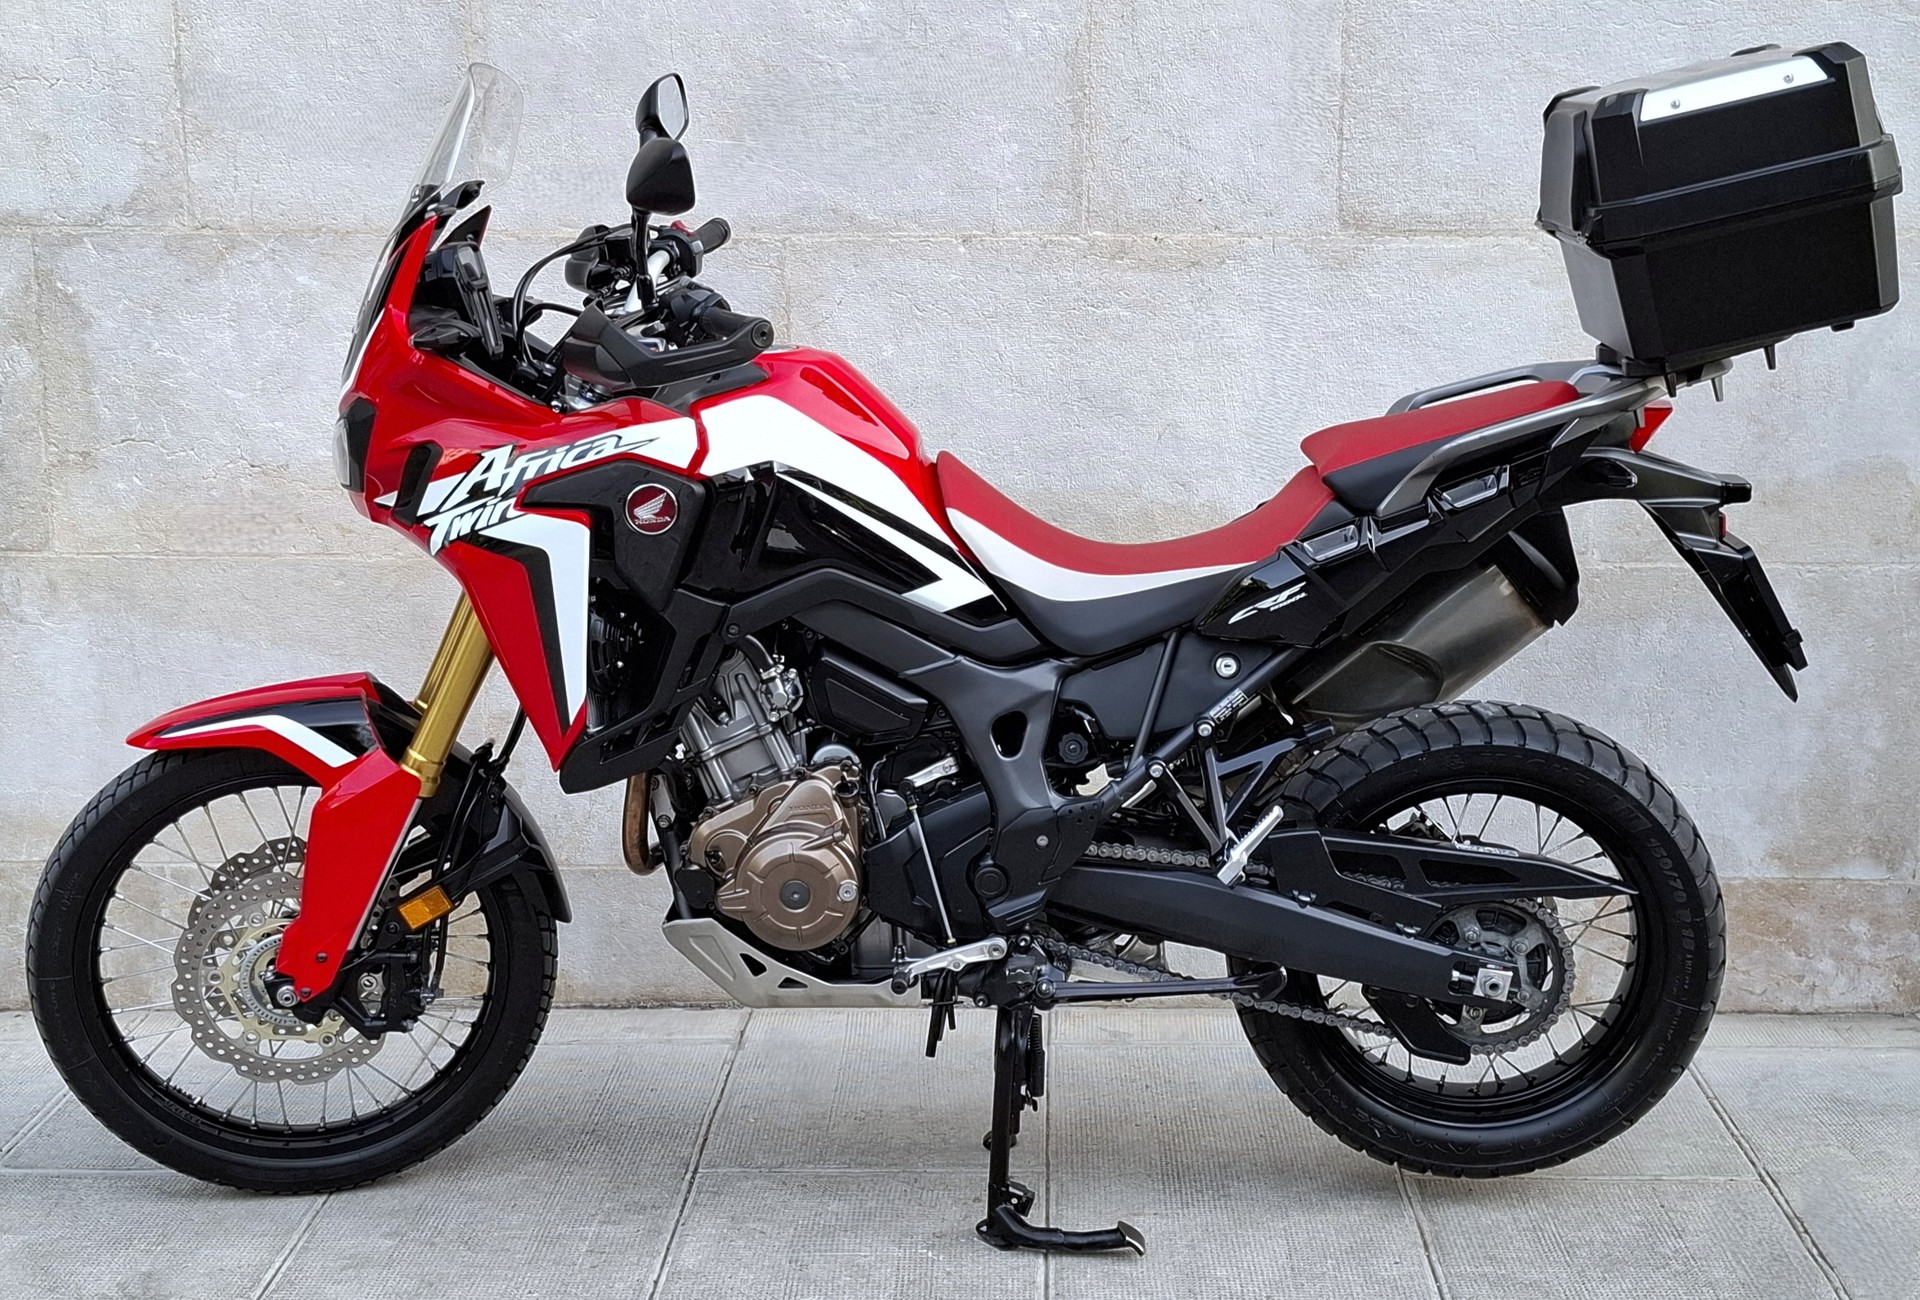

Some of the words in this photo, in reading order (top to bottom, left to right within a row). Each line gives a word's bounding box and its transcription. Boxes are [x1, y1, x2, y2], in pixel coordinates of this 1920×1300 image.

[439, 434, 660, 513] Africa
[423, 497, 532, 557] Twin
[634, 516, 671, 525] HONDA
